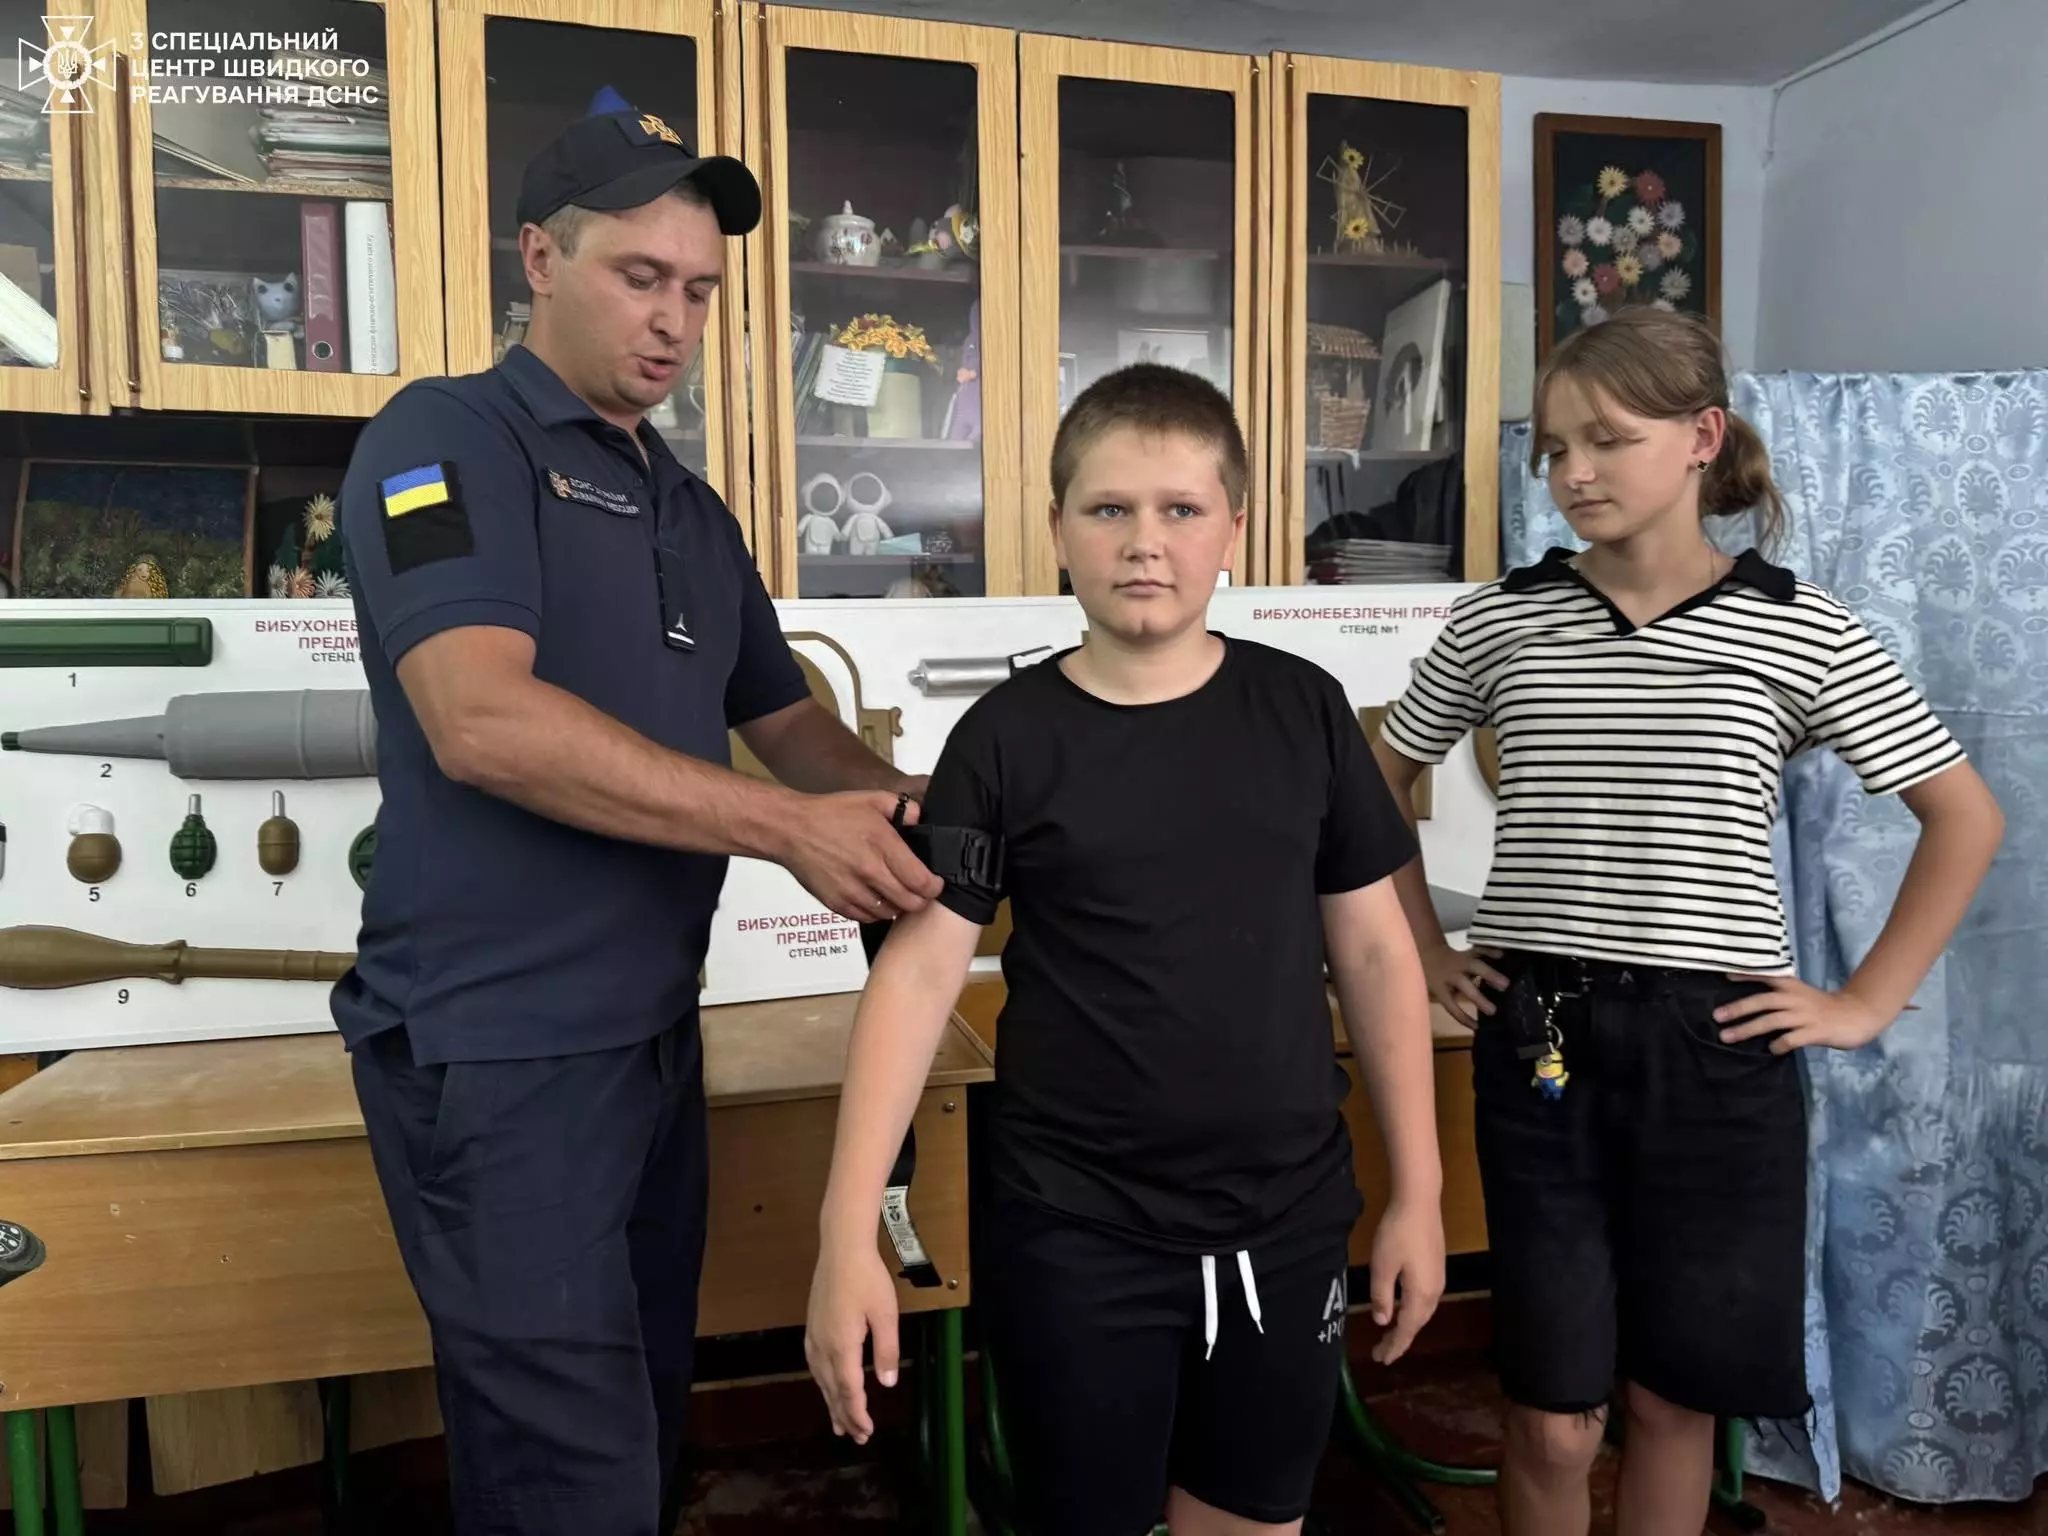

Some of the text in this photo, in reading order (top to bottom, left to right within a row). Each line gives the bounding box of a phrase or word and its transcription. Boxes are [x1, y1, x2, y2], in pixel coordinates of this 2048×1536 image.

[1253, 607, 1408, 620] ВИБУХОНЕБЕЗПЕЧНІ
[1340, 625, 1378, 635] СТЕНД
[298, 636, 360, 651] ПРЕДМ
[311, 651, 356, 663] СТЕНД
[68, 672, 77, 687] 1
[100, 763, 113, 778] 2
[88, 886, 101, 902] 5
[185, 882, 197, 897] 6
[272, 881, 284, 896] 7
[776, 927, 858, 945] ПРЕДМЕТИ
[789, 946, 827, 959] СТЕНД
[118, 988, 130, 1004] 9
